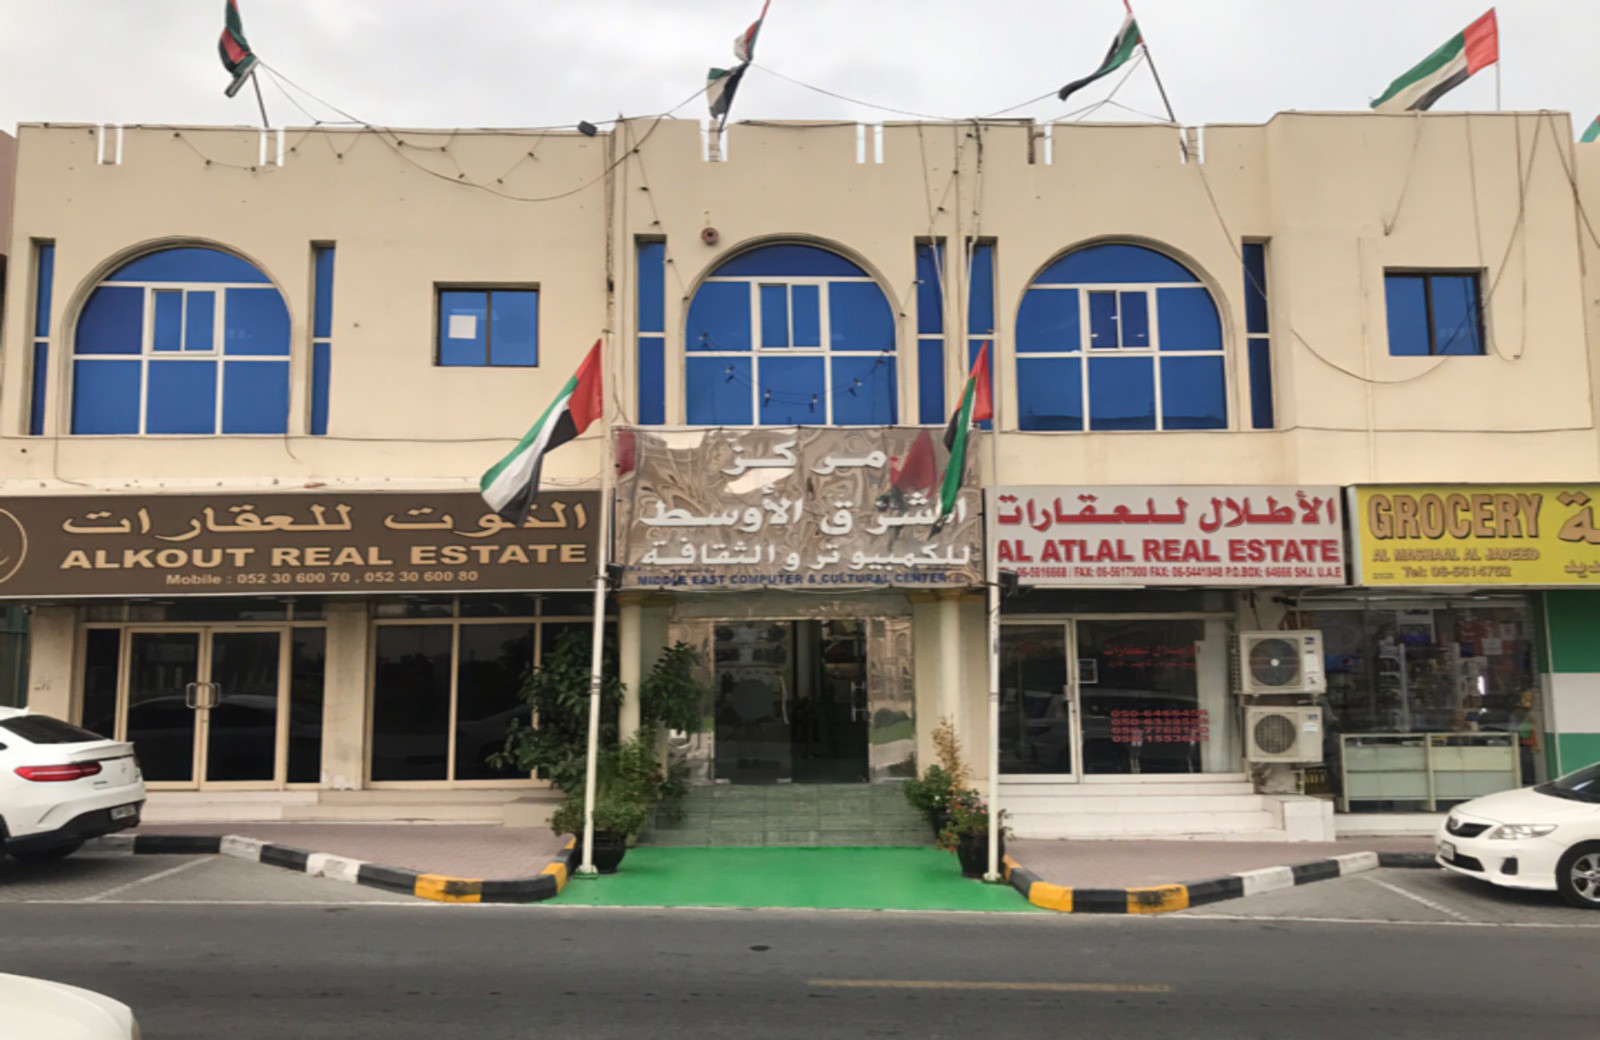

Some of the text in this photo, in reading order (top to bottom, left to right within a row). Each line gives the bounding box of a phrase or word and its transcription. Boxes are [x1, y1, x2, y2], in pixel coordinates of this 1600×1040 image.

[720, 437, 888, 476] مركز
[62, 503, 353, 542] للعقارات
[638, 485, 967, 535] اشرق الأوسط
[997, 490, 1336, 533] الأطلال للعقارات
[1367, 493, 1543, 540] GROCERY
[60, 544, 587, 569] ALKOUT REAL ESTATE
[997, 539, 1340, 562] AL ATLAL REAL ESTATE
[165, 574, 222, 585] Mobile
[236, 573, 267, 584] 052
[271, 573, 291, 584] 30
[296, 572, 326, 583] 600
[331, 572, 350, 583] 70
[363, 572, 395, 583] 052
[399, 571, 419, 582] 30
[424, 571, 454, 582] 600
[637, 572, 948, 586] MIDDLE EAST COMPUTER & CULTURAL CENTER
